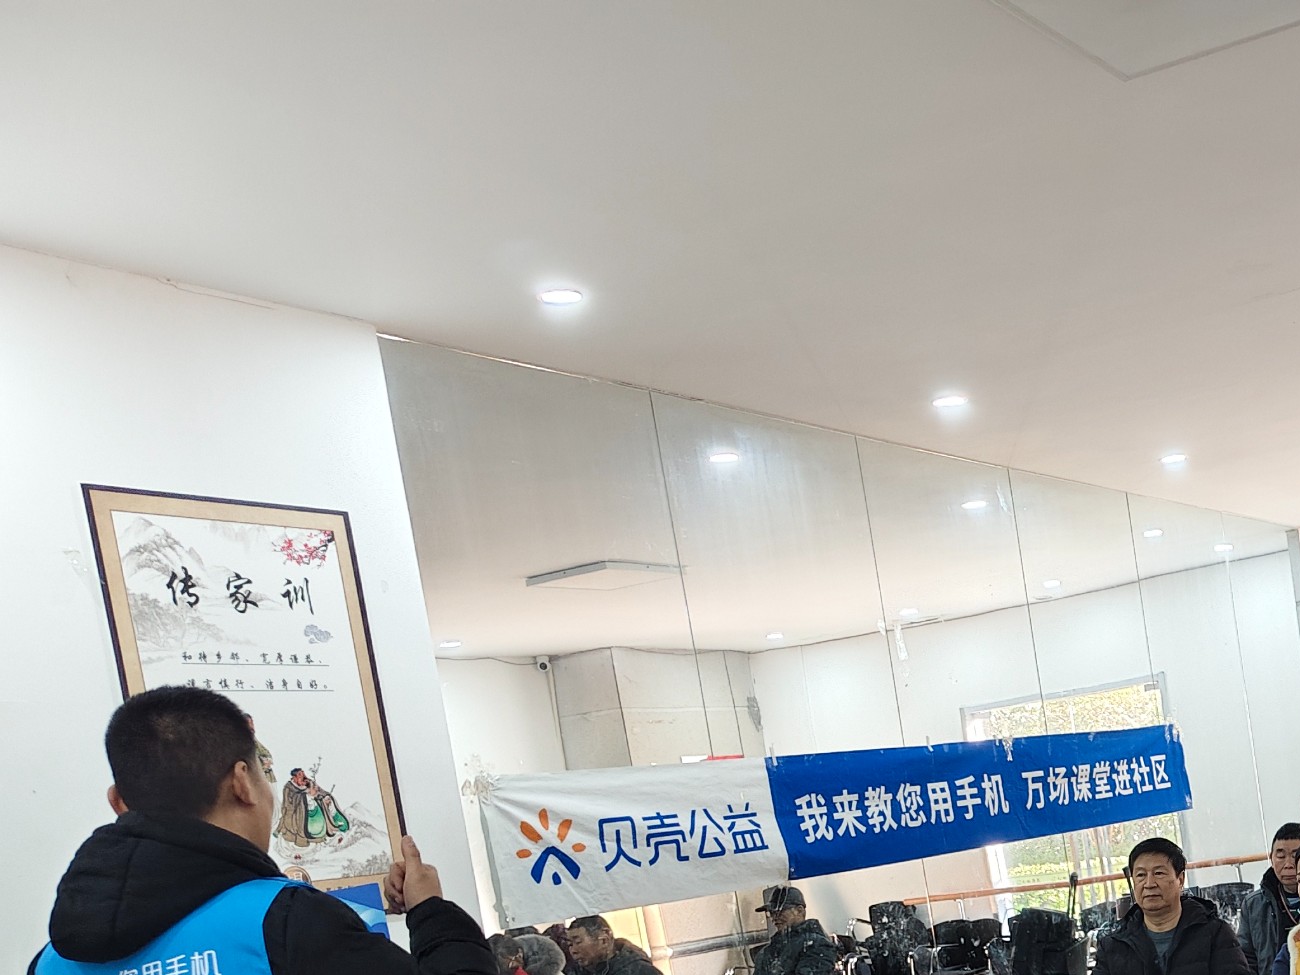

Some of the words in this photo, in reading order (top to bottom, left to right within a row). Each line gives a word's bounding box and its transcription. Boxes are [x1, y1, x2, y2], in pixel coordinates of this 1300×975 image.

[166, 566, 315, 615] 传家训
[795, 772, 1010, 844] 我来教您用手机
[1021, 753, 1173, 812] 万场课堂进社区
[598, 801, 769, 873] 贝壳公益
